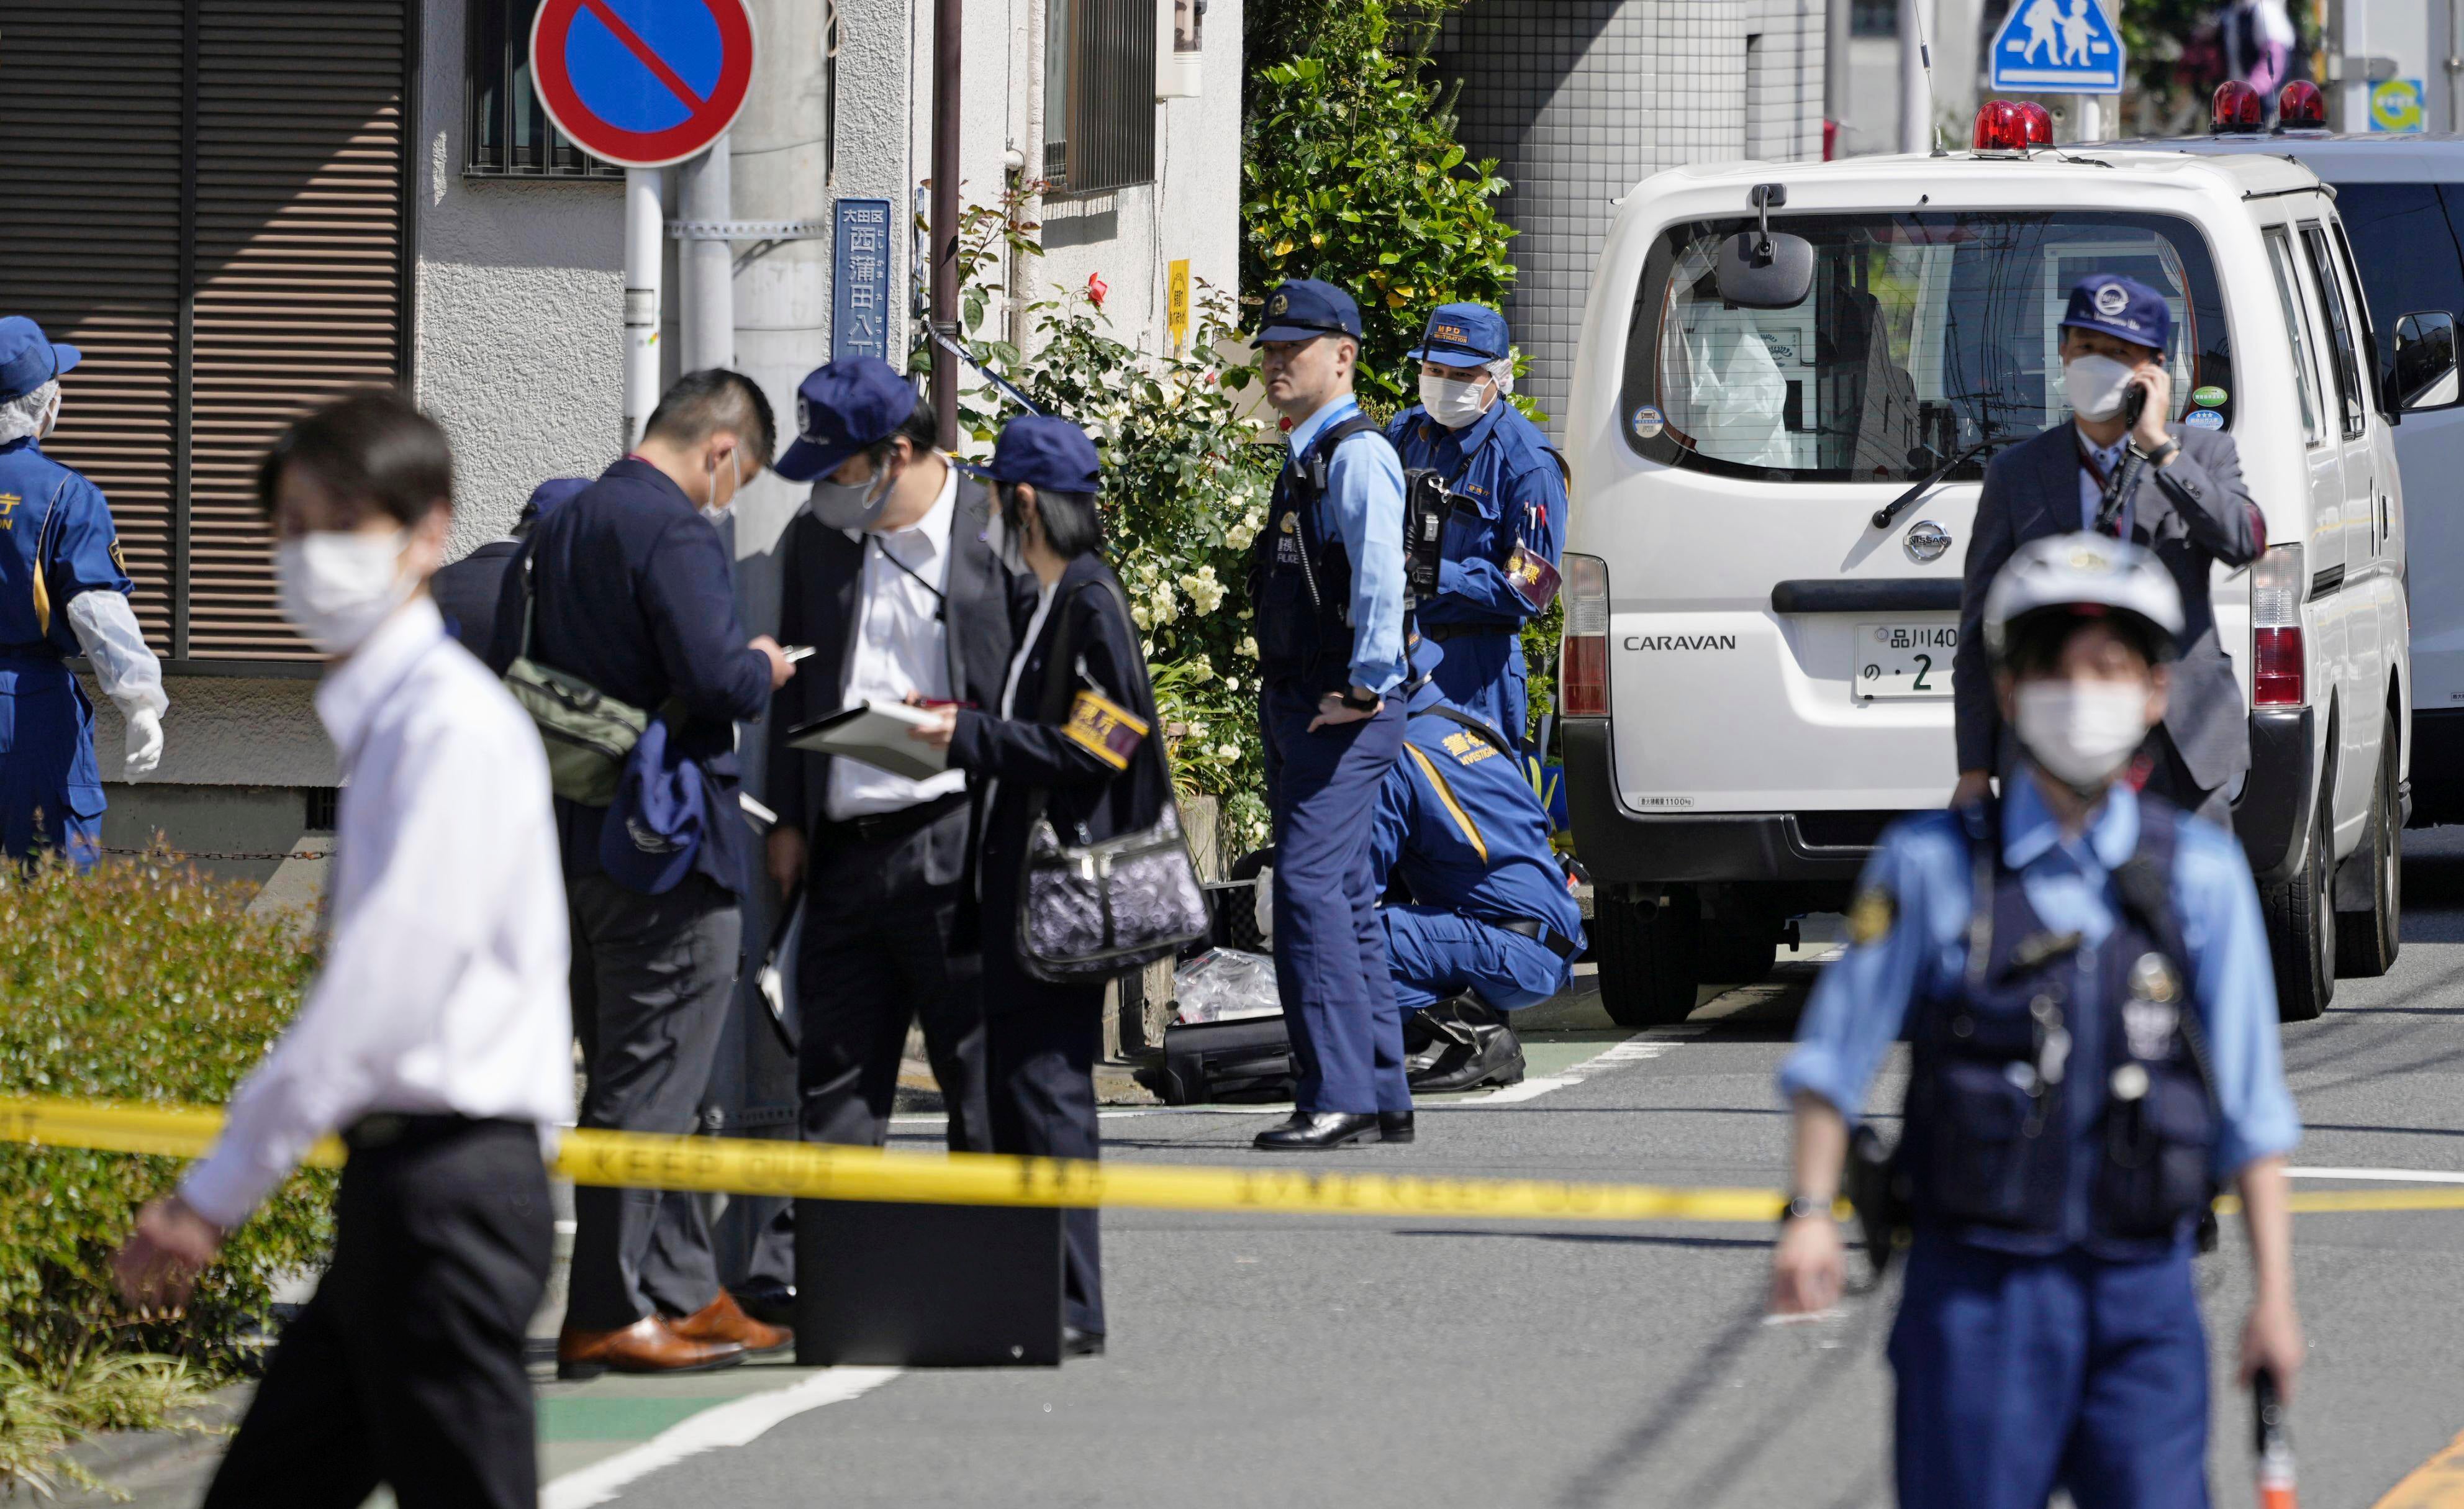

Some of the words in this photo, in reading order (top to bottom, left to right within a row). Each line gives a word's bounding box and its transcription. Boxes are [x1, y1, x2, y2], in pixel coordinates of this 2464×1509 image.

[843, 209, 884, 224] 大田区
[1438, 325, 1461, 334] MPD
[1909, 535, 1949, 546] NISSAN
[1623, 635, 1736, 651] CARAVAN
